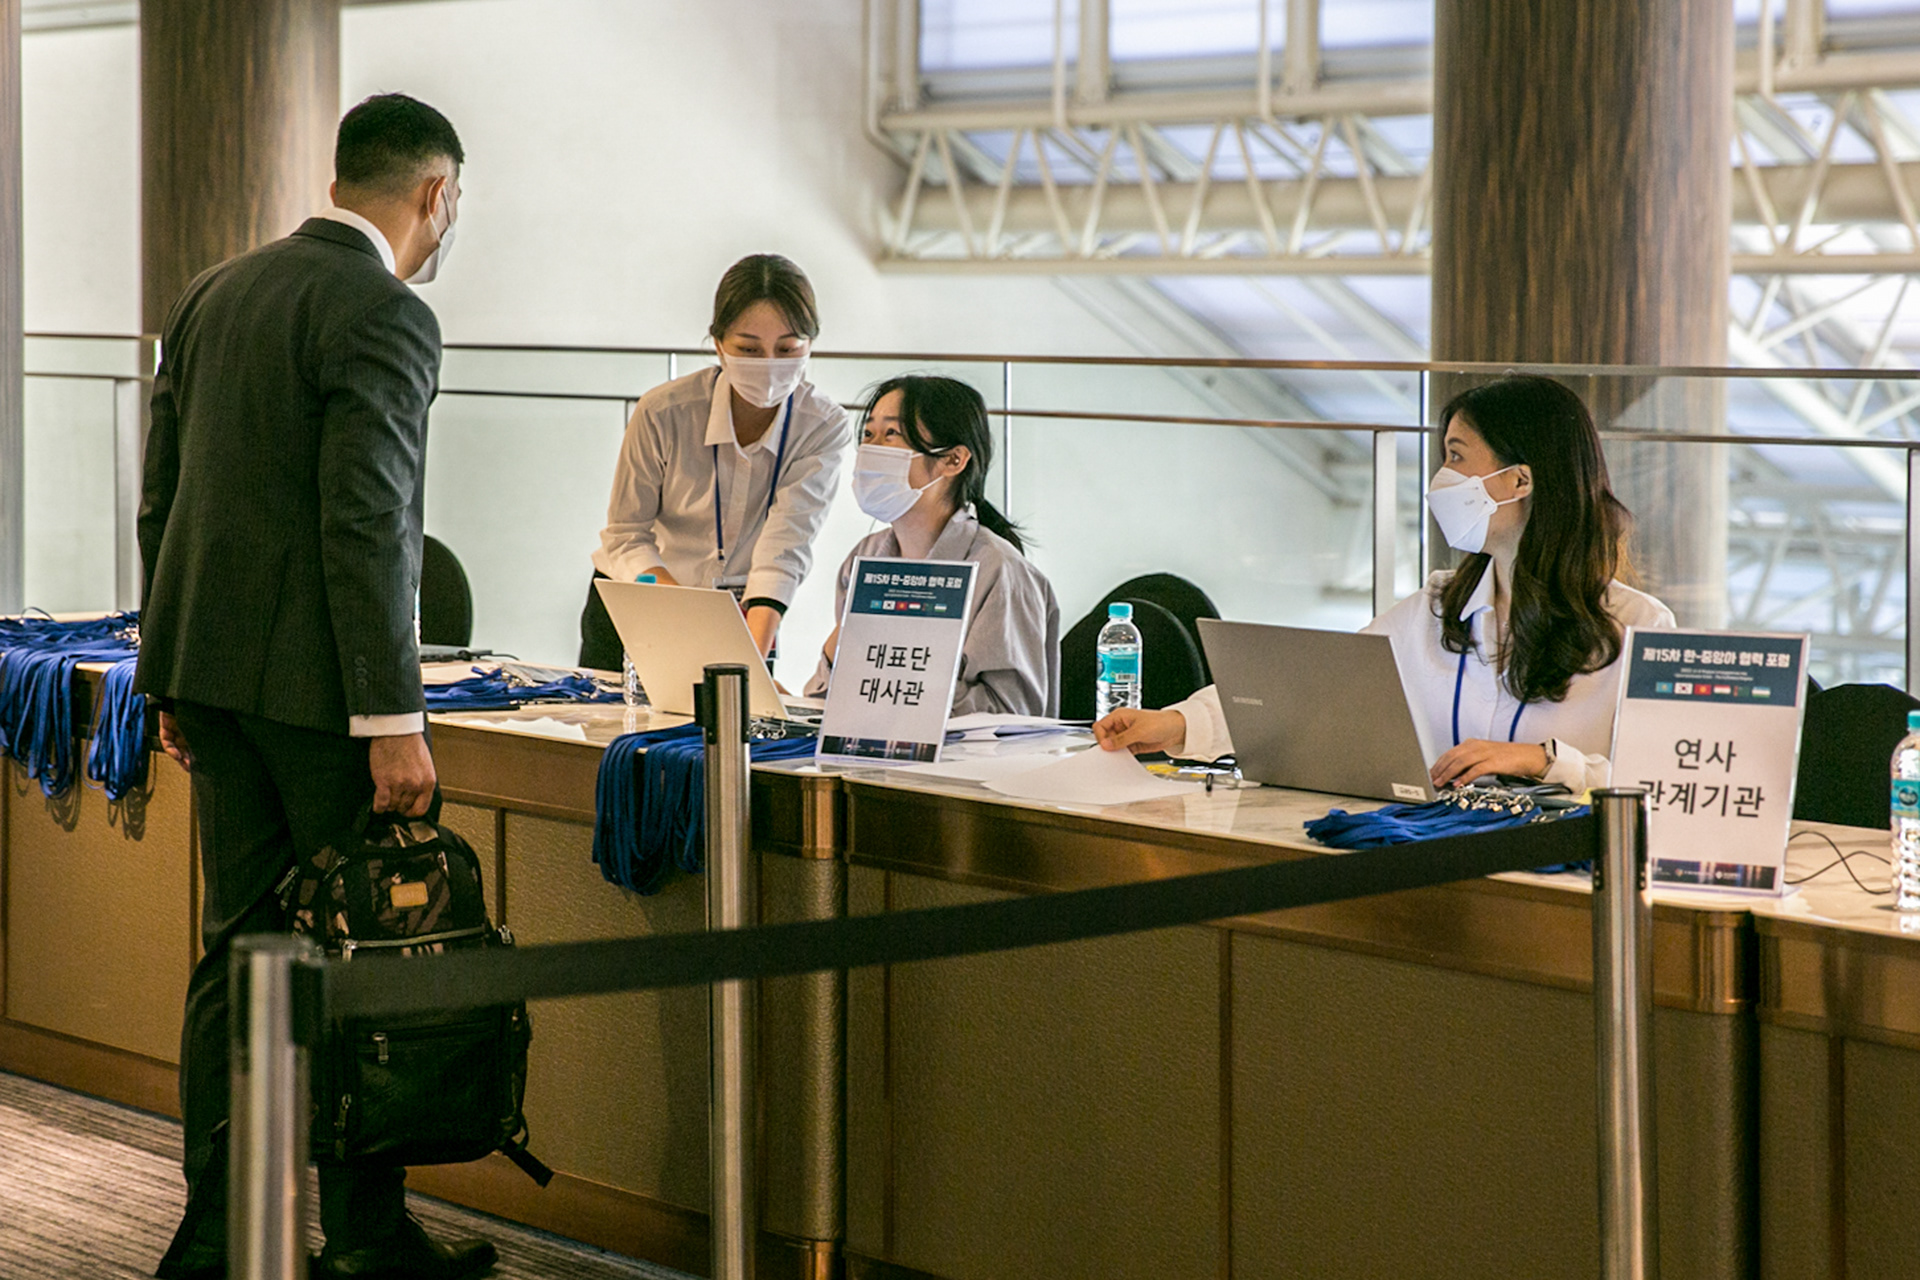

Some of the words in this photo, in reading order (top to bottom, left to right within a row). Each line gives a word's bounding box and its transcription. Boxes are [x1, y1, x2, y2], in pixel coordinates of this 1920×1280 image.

[863, 573, 890, 585] 제15차
[945, 577, 963, 589] 포럼
[866, 644, 931, 671] 대표단
[1642, 647, 1681, 662] 제15차
[1683, 649, 1736, 665] 한-중앙아
[1739, 652, 1764, 667] 협력
[1765, 653, 1791, 668] 포럼
[860, 678, 925, 706] 대사관
[1675, 739, 1737, 773] 연사
